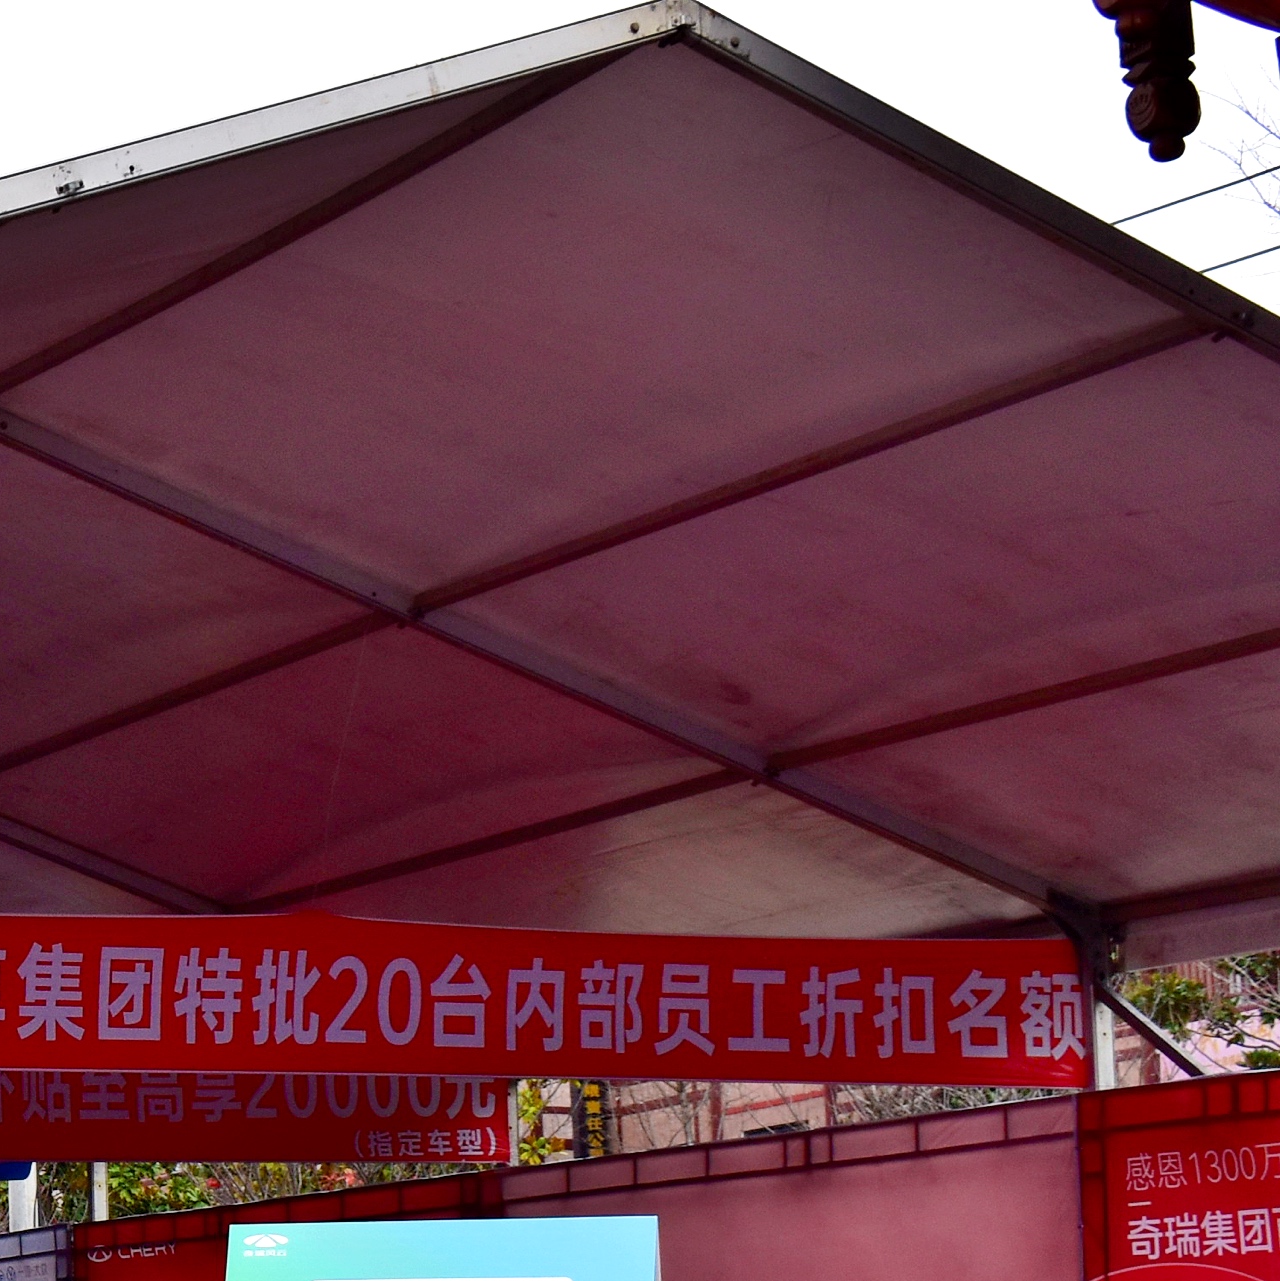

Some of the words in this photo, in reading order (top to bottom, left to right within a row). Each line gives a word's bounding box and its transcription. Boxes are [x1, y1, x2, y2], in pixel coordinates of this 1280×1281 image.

[354, 1127, 496, 1158] (指定车型)
[1127, 1207, 1280, 1260] 奇瑞集团
